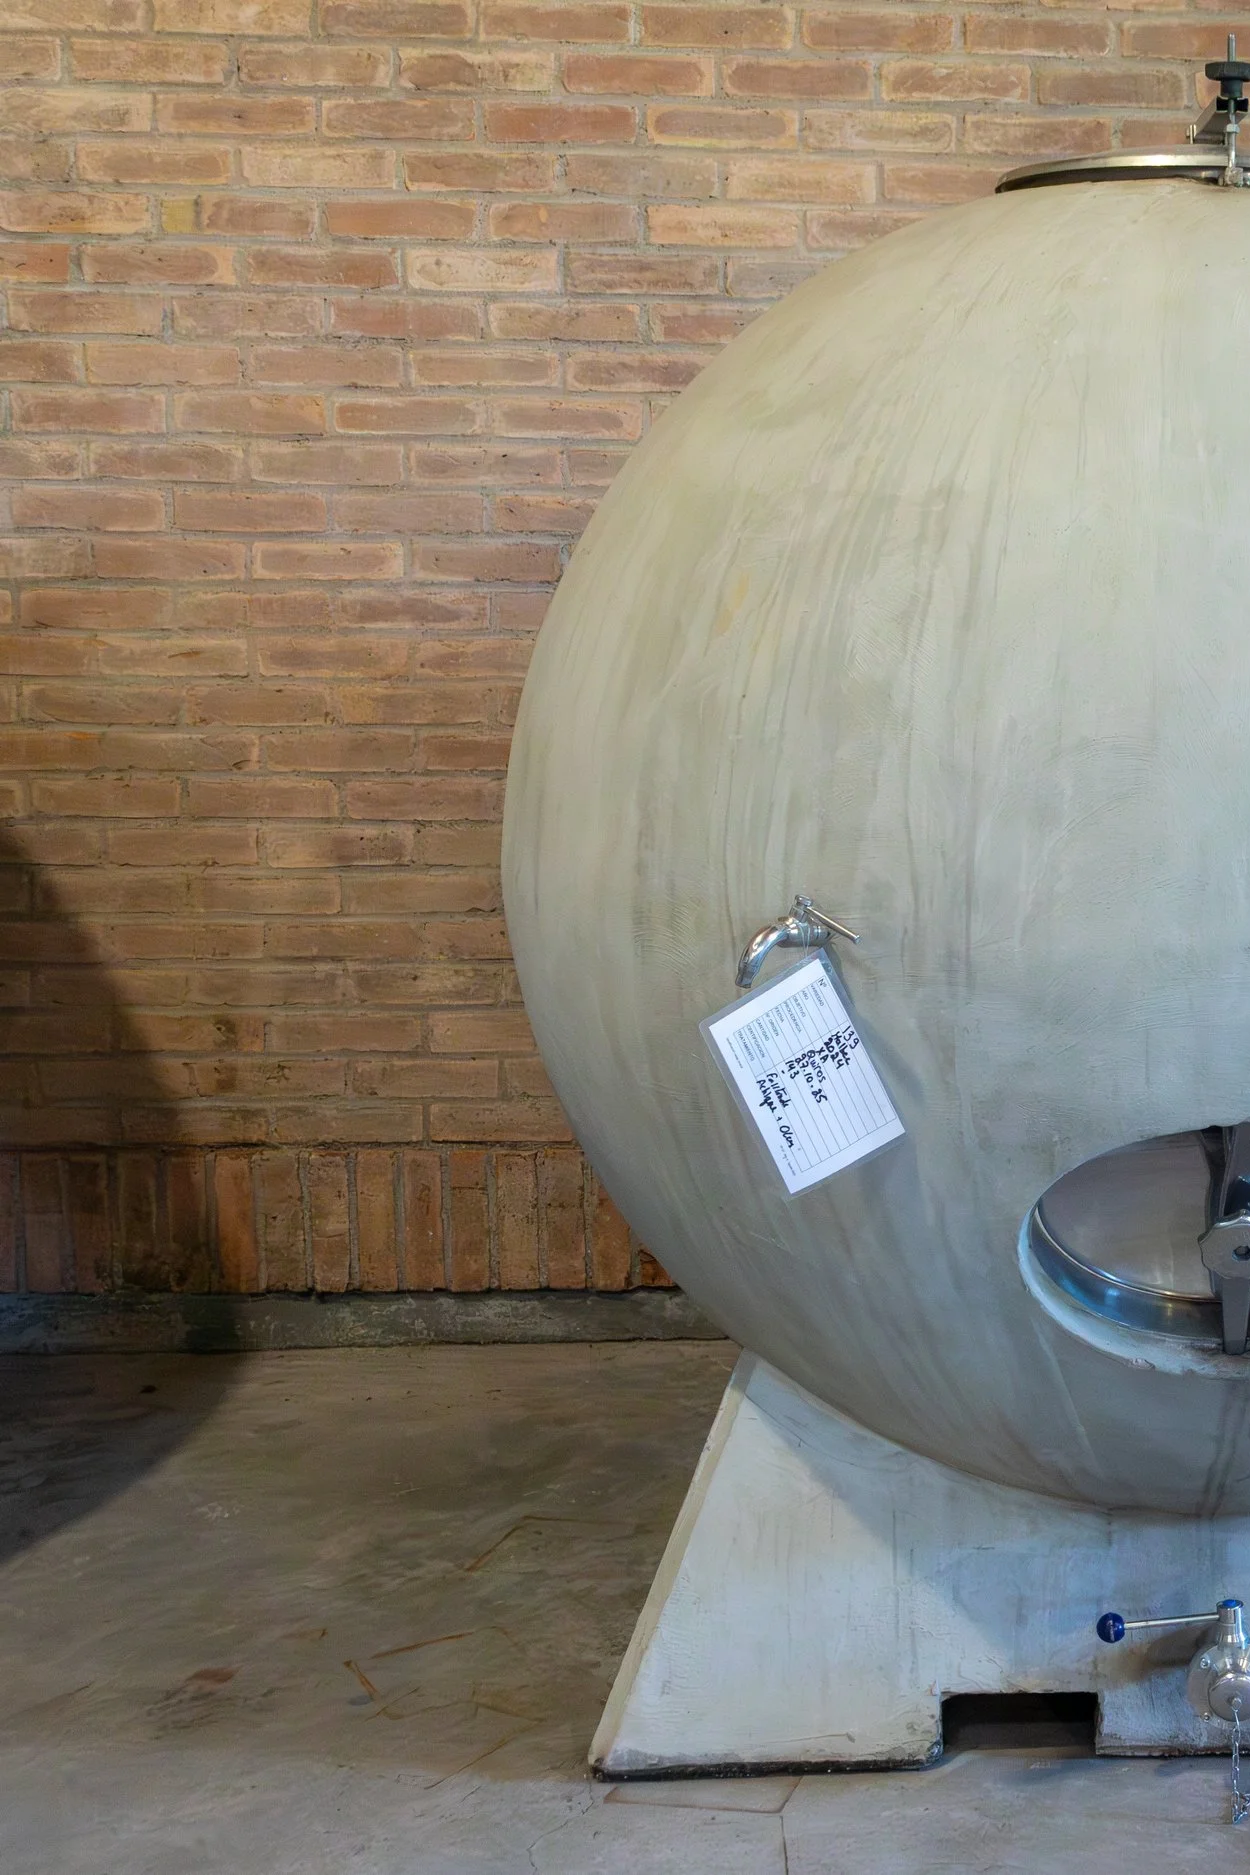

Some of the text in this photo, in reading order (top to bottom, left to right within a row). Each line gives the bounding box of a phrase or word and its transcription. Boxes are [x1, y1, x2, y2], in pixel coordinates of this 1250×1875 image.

[774, 1006, 784, 1023] FECHA
[738, 1030, 755, 1061] TRATAMIENTO
[841, 1025, 860, 1050] 139
[823, 1036, 844, 1070] 2024
